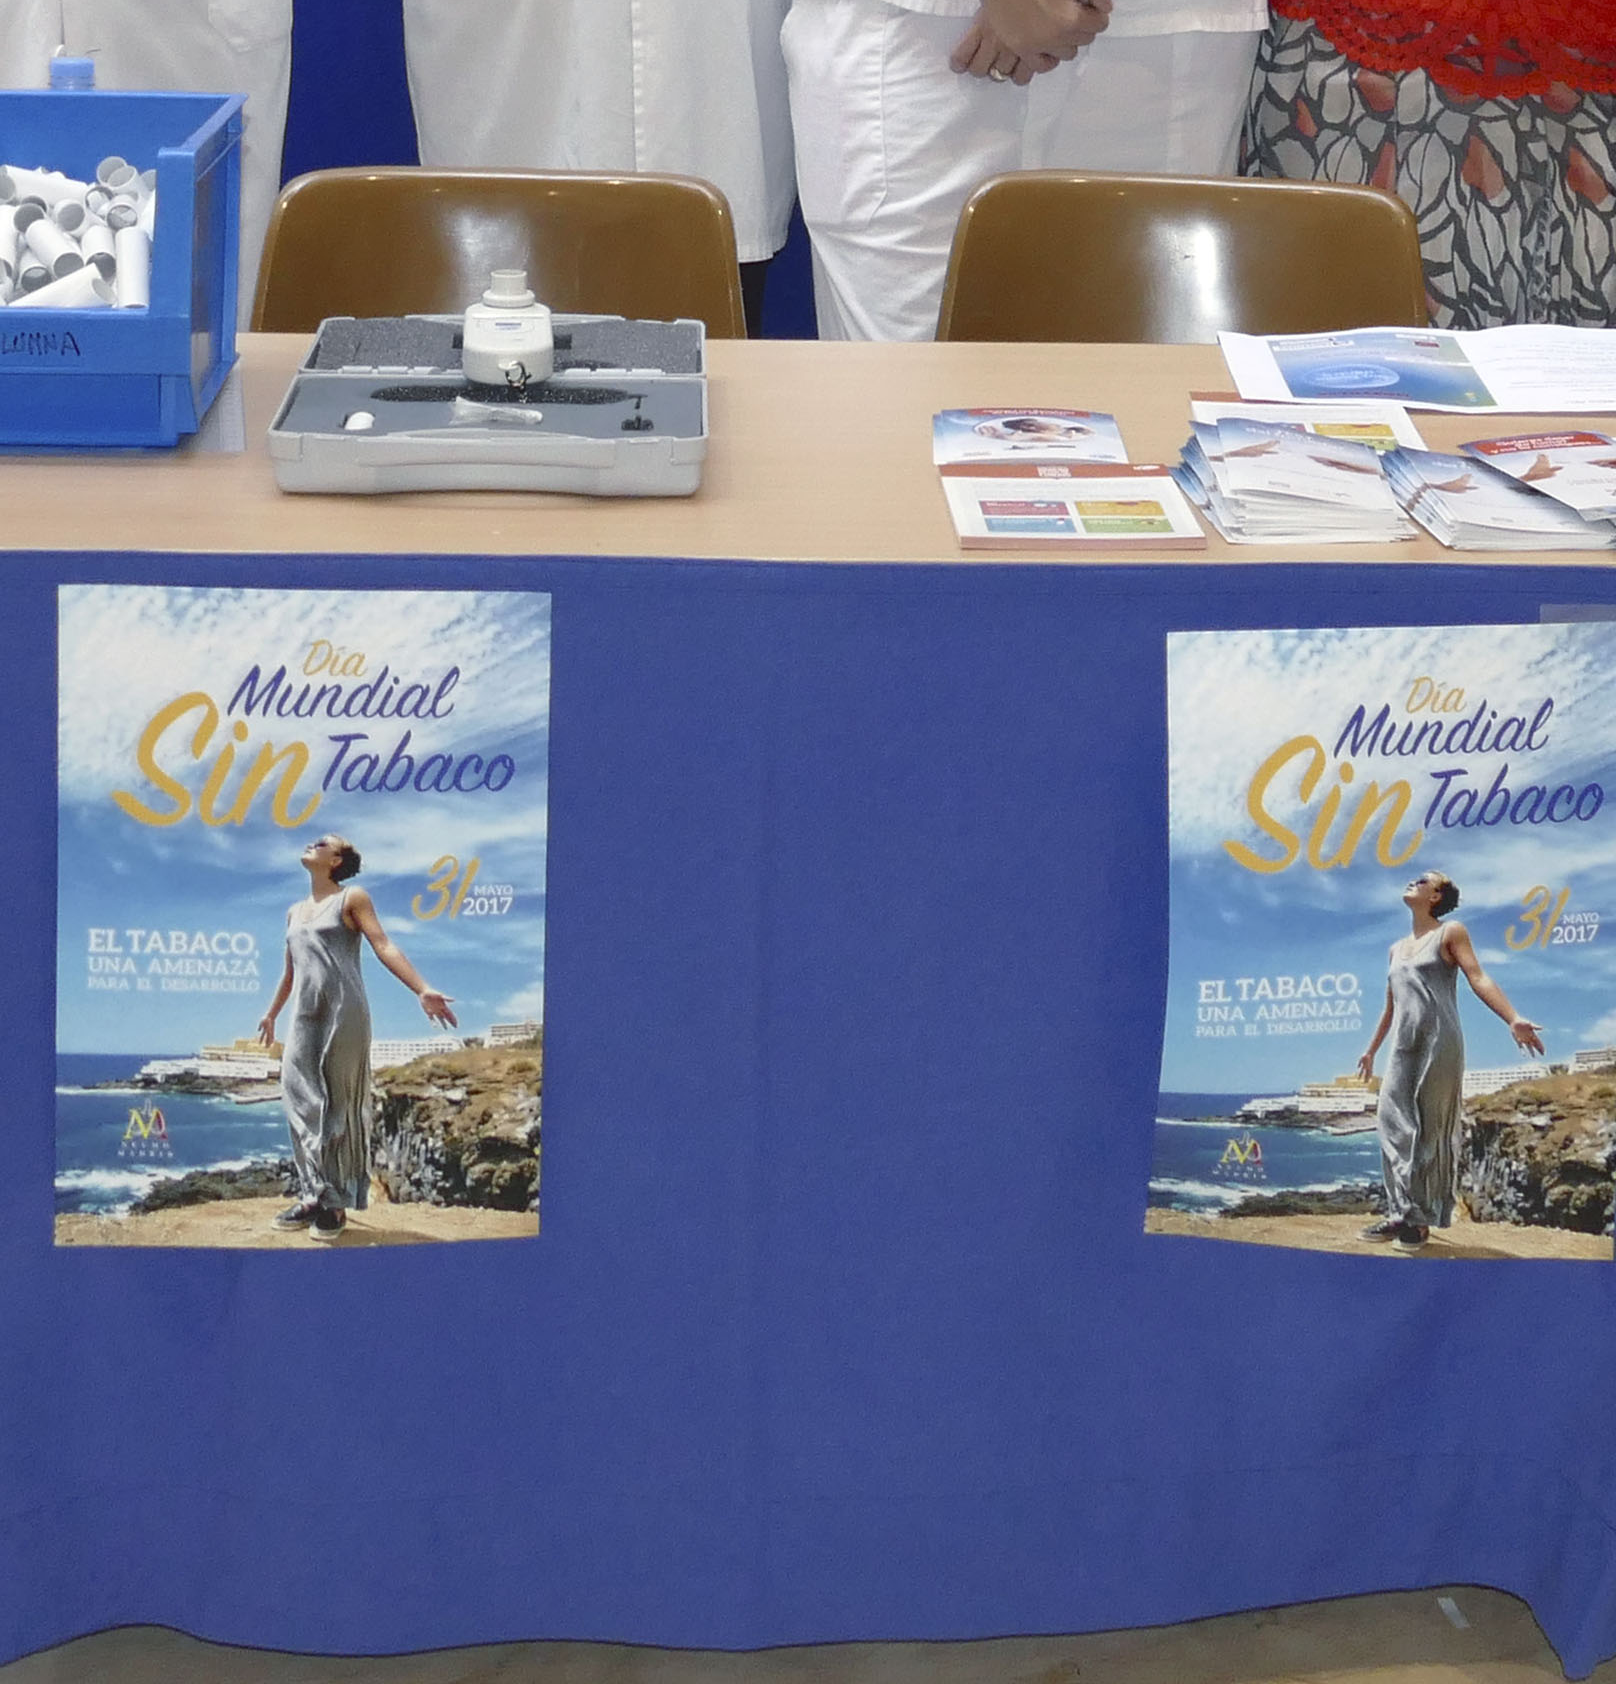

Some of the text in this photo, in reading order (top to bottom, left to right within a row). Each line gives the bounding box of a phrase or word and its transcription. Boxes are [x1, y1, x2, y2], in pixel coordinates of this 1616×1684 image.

[301, 638, 369, 678] Día
[226, 663, 462, 720] Mundial
[1405, 675, 1467, 714] Día
[1333, 696, 1555, 759] Mundial
[108, 690, 323, 829] Sin
[320, 728, 516, 795] Tabaco
[1222, 733, 1425, 875] Sin
[1422, 763, 1606, 829] Tabaco
[410, 852, 483, 921] 31
[472, 883, 515, 897] MAYO
[461, 895, 514, 917] 2017
[1504, 883, 1571, 952] 31
[1562, 911, 1601, 925] MAYO
[87, 927, 261, 960] EL TABACO,
[1550, 922, 1600, 946] 2017
[87, 955, 261, 977] UNA AMENAZA
[87, 976, 261, 993] PARA EL DESARROLLO
[1197, 972, 1363, 1003] EL TABACO,
[1195, 1017, 1363, 1038] PARA EL DESARROLLO
[1196, 999, 1362, 1023] UNA AMENAZA
